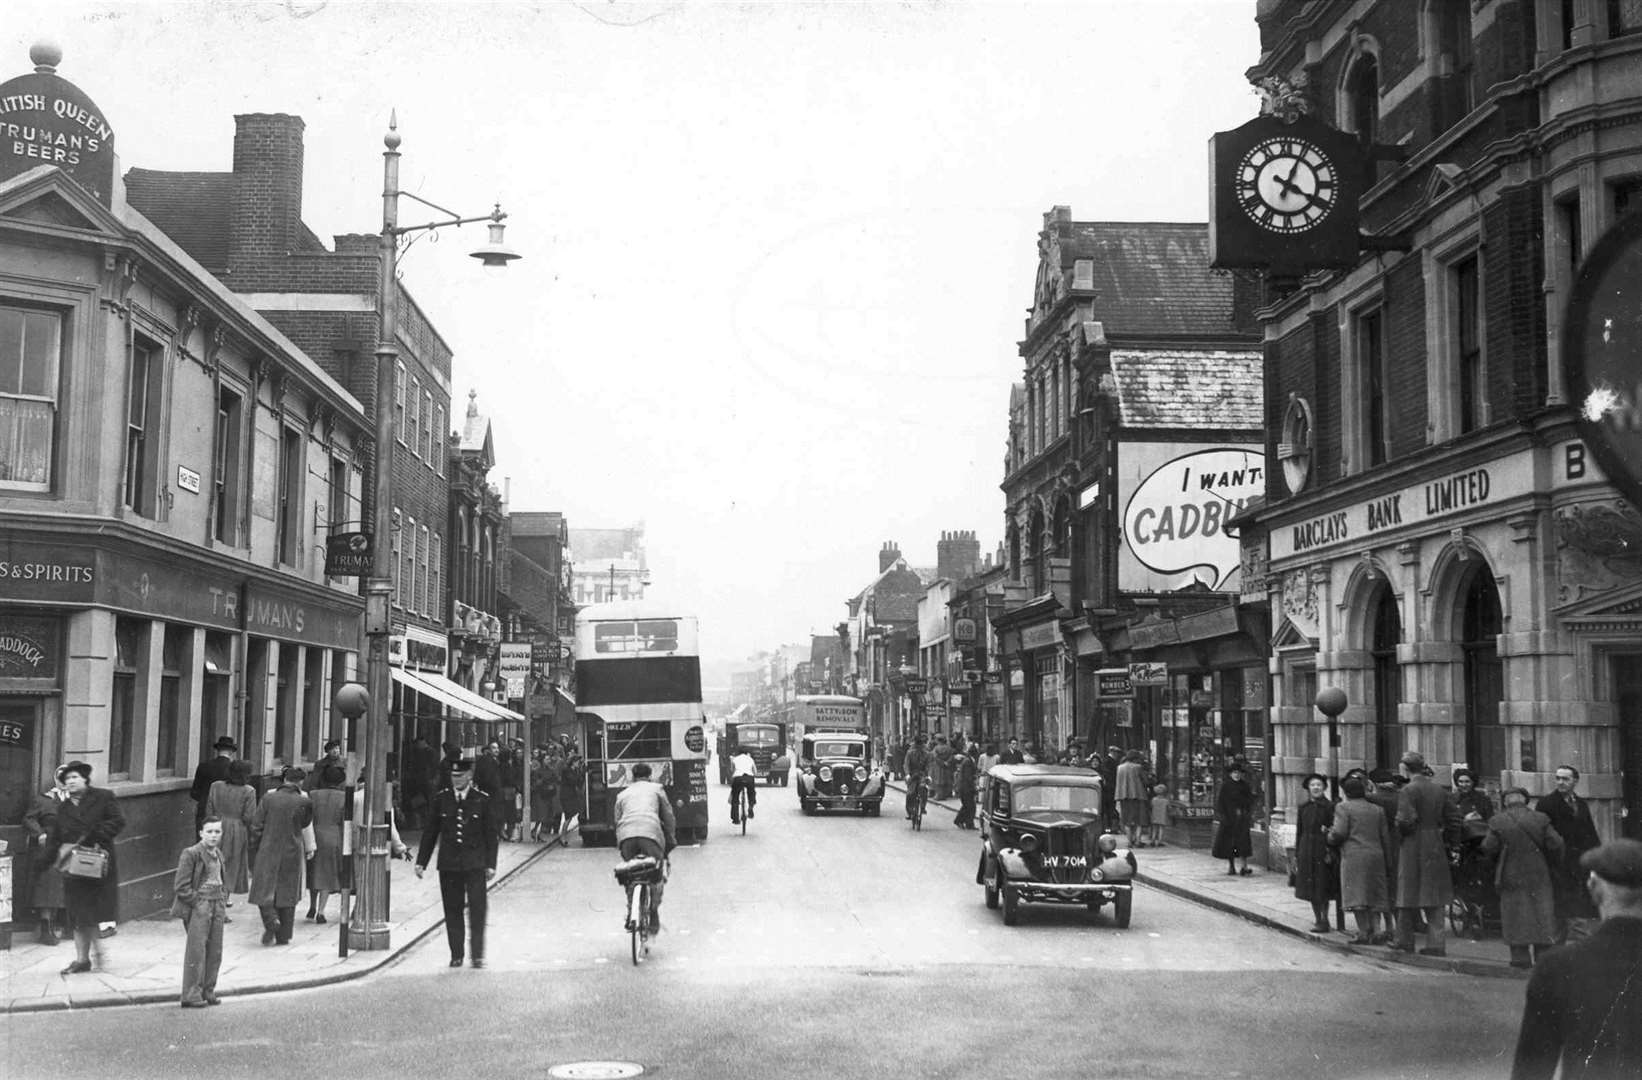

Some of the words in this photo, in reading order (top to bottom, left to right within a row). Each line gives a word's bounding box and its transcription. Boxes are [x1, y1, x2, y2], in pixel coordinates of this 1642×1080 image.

[53, 99, 112, 141] QUEEN
[0, 122, 99, 152] TRUMAN'S
[13, 141, 80, 165] BEERS
[1182, 467, 1190, 492] I
[1293, 511, 1348, 551] BARCLAYS
[1367, 495, 1402, 532] BANK
[1425, 468, 1490, 515] LIMITED
[24, 564, 93, 583] SPIRITS
[1044, 856, 1059, 867] HV
[1064, 855, 1087, 867] 7014
